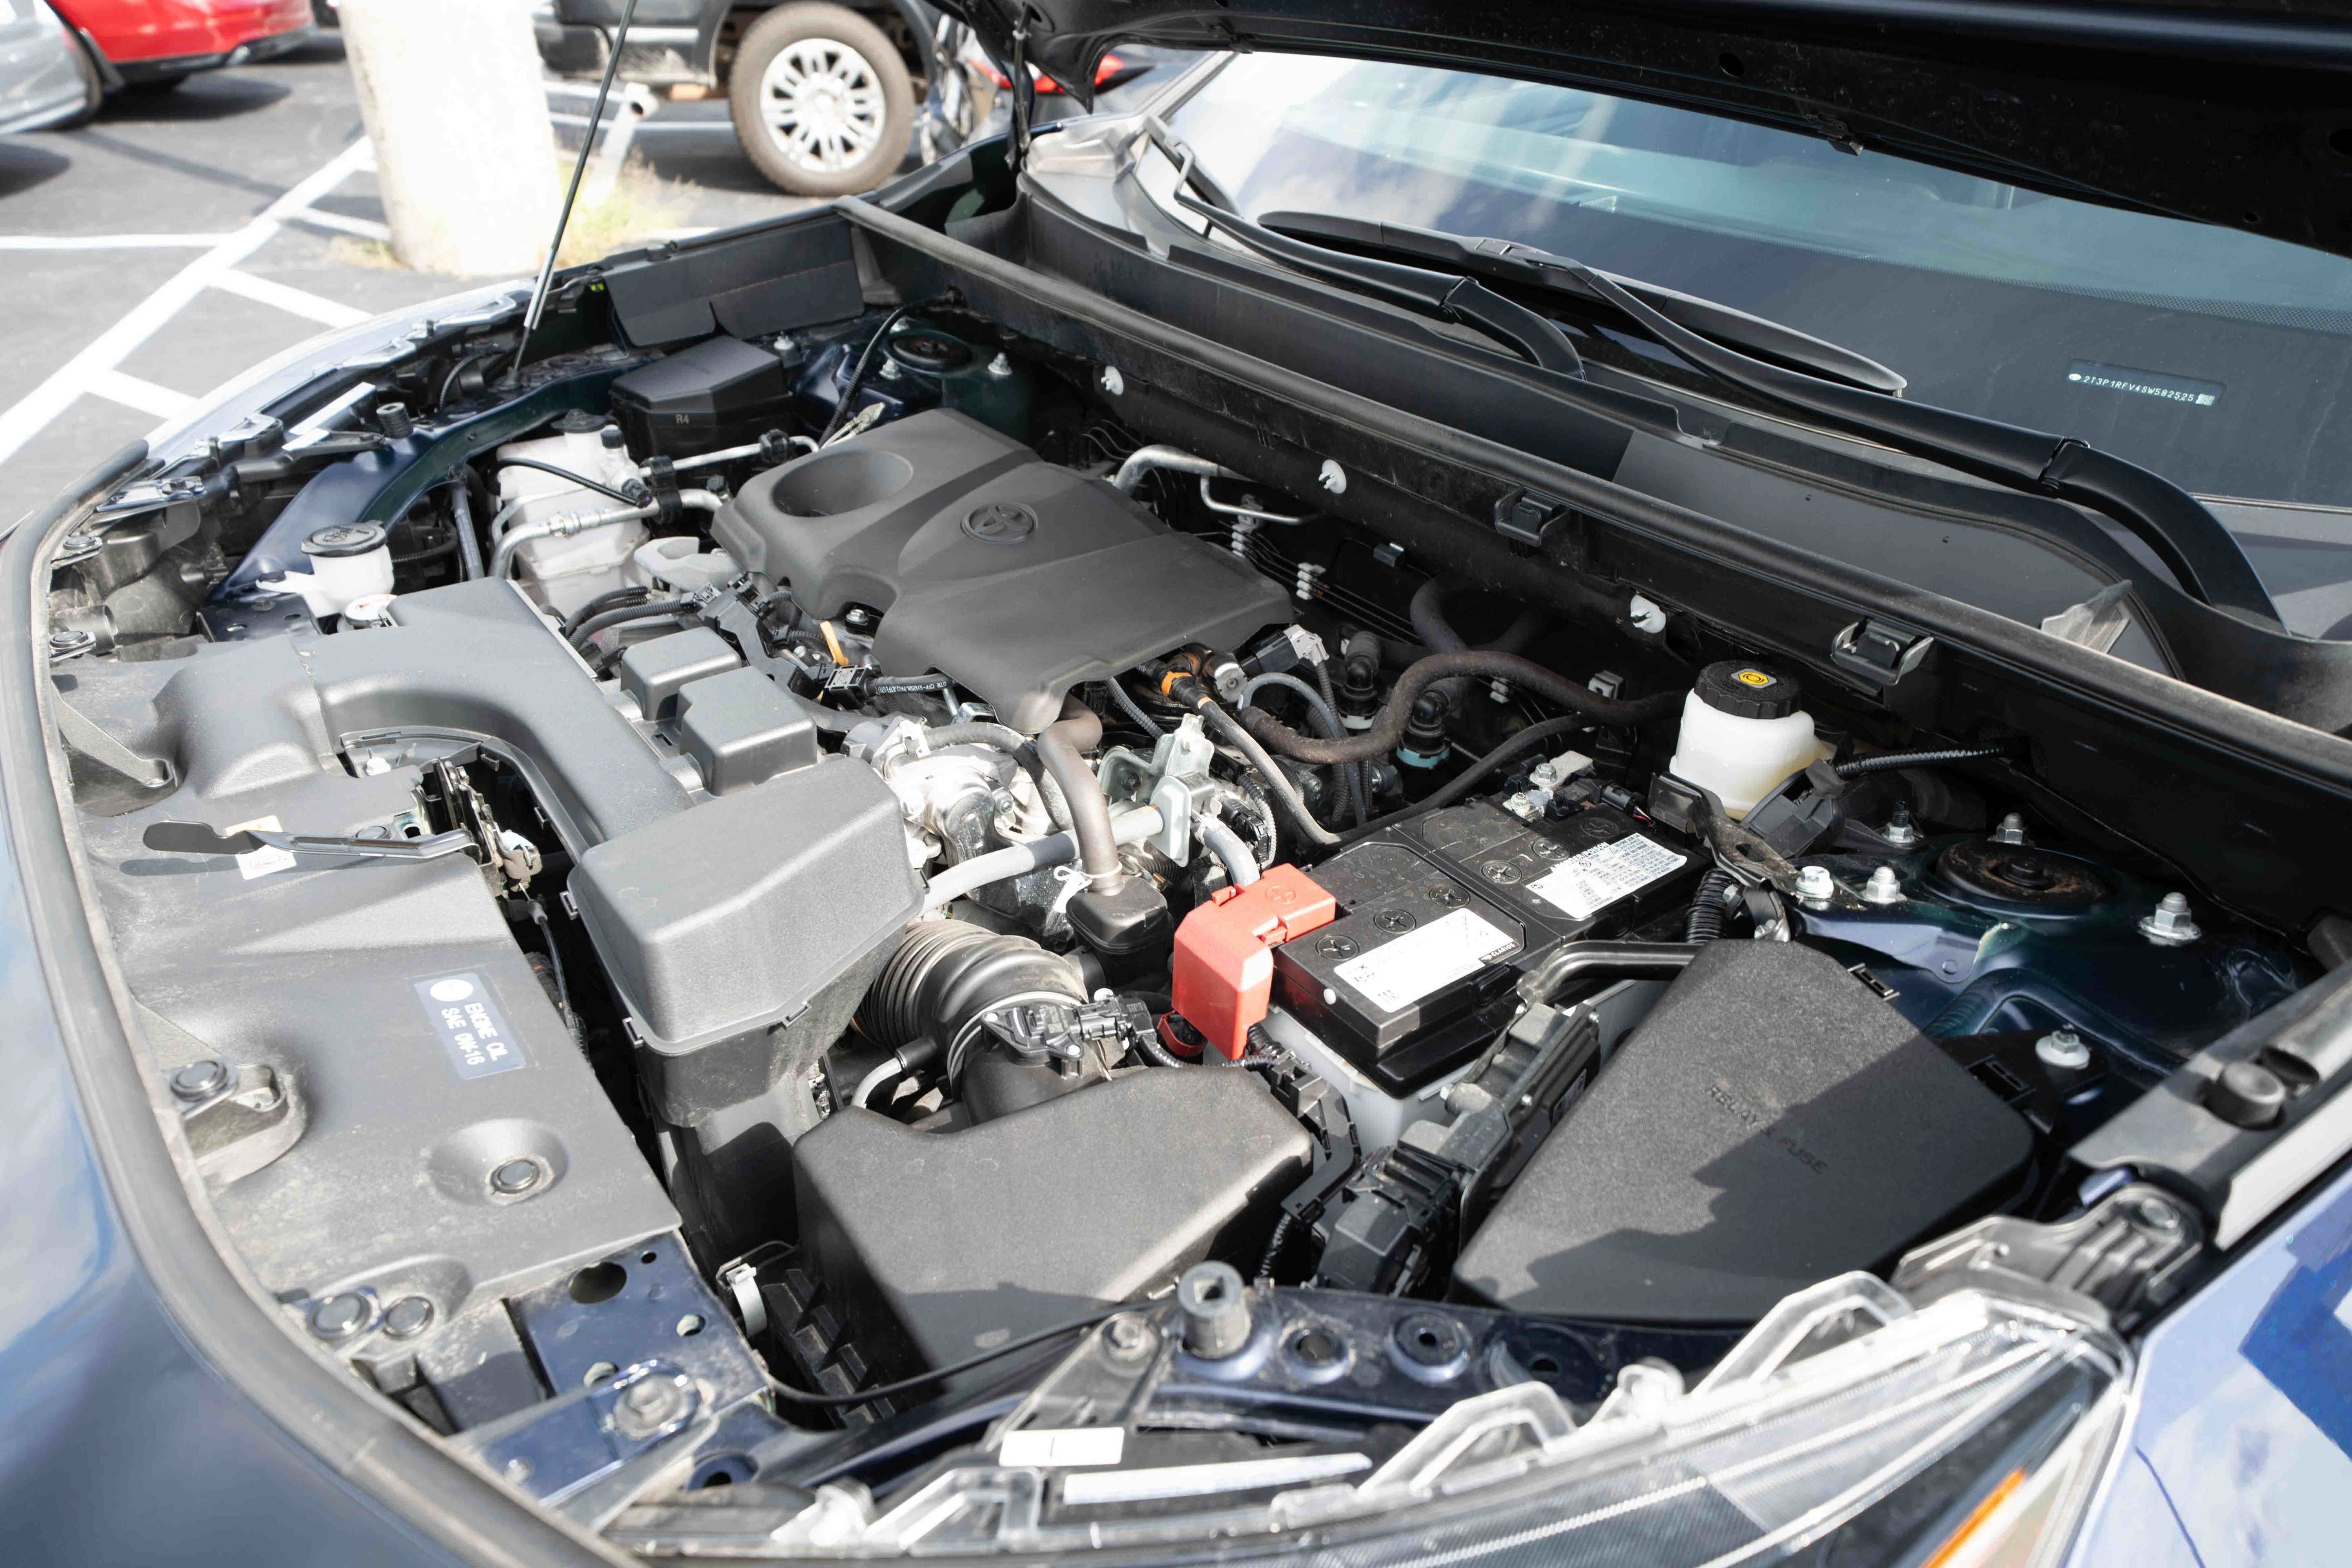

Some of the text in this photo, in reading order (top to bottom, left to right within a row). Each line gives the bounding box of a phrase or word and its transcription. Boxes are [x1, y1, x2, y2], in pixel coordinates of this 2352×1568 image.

[2083, 375, 2195, 401] 2T3P1RFV4SW582525
[676, 414, 689, 424] R4
[1491, 943, 1515, 957] CLARIOS
[464, 1002, 498, 1039] ENGINE
[441, 1007, 485, 1065] SAE 0W-16
